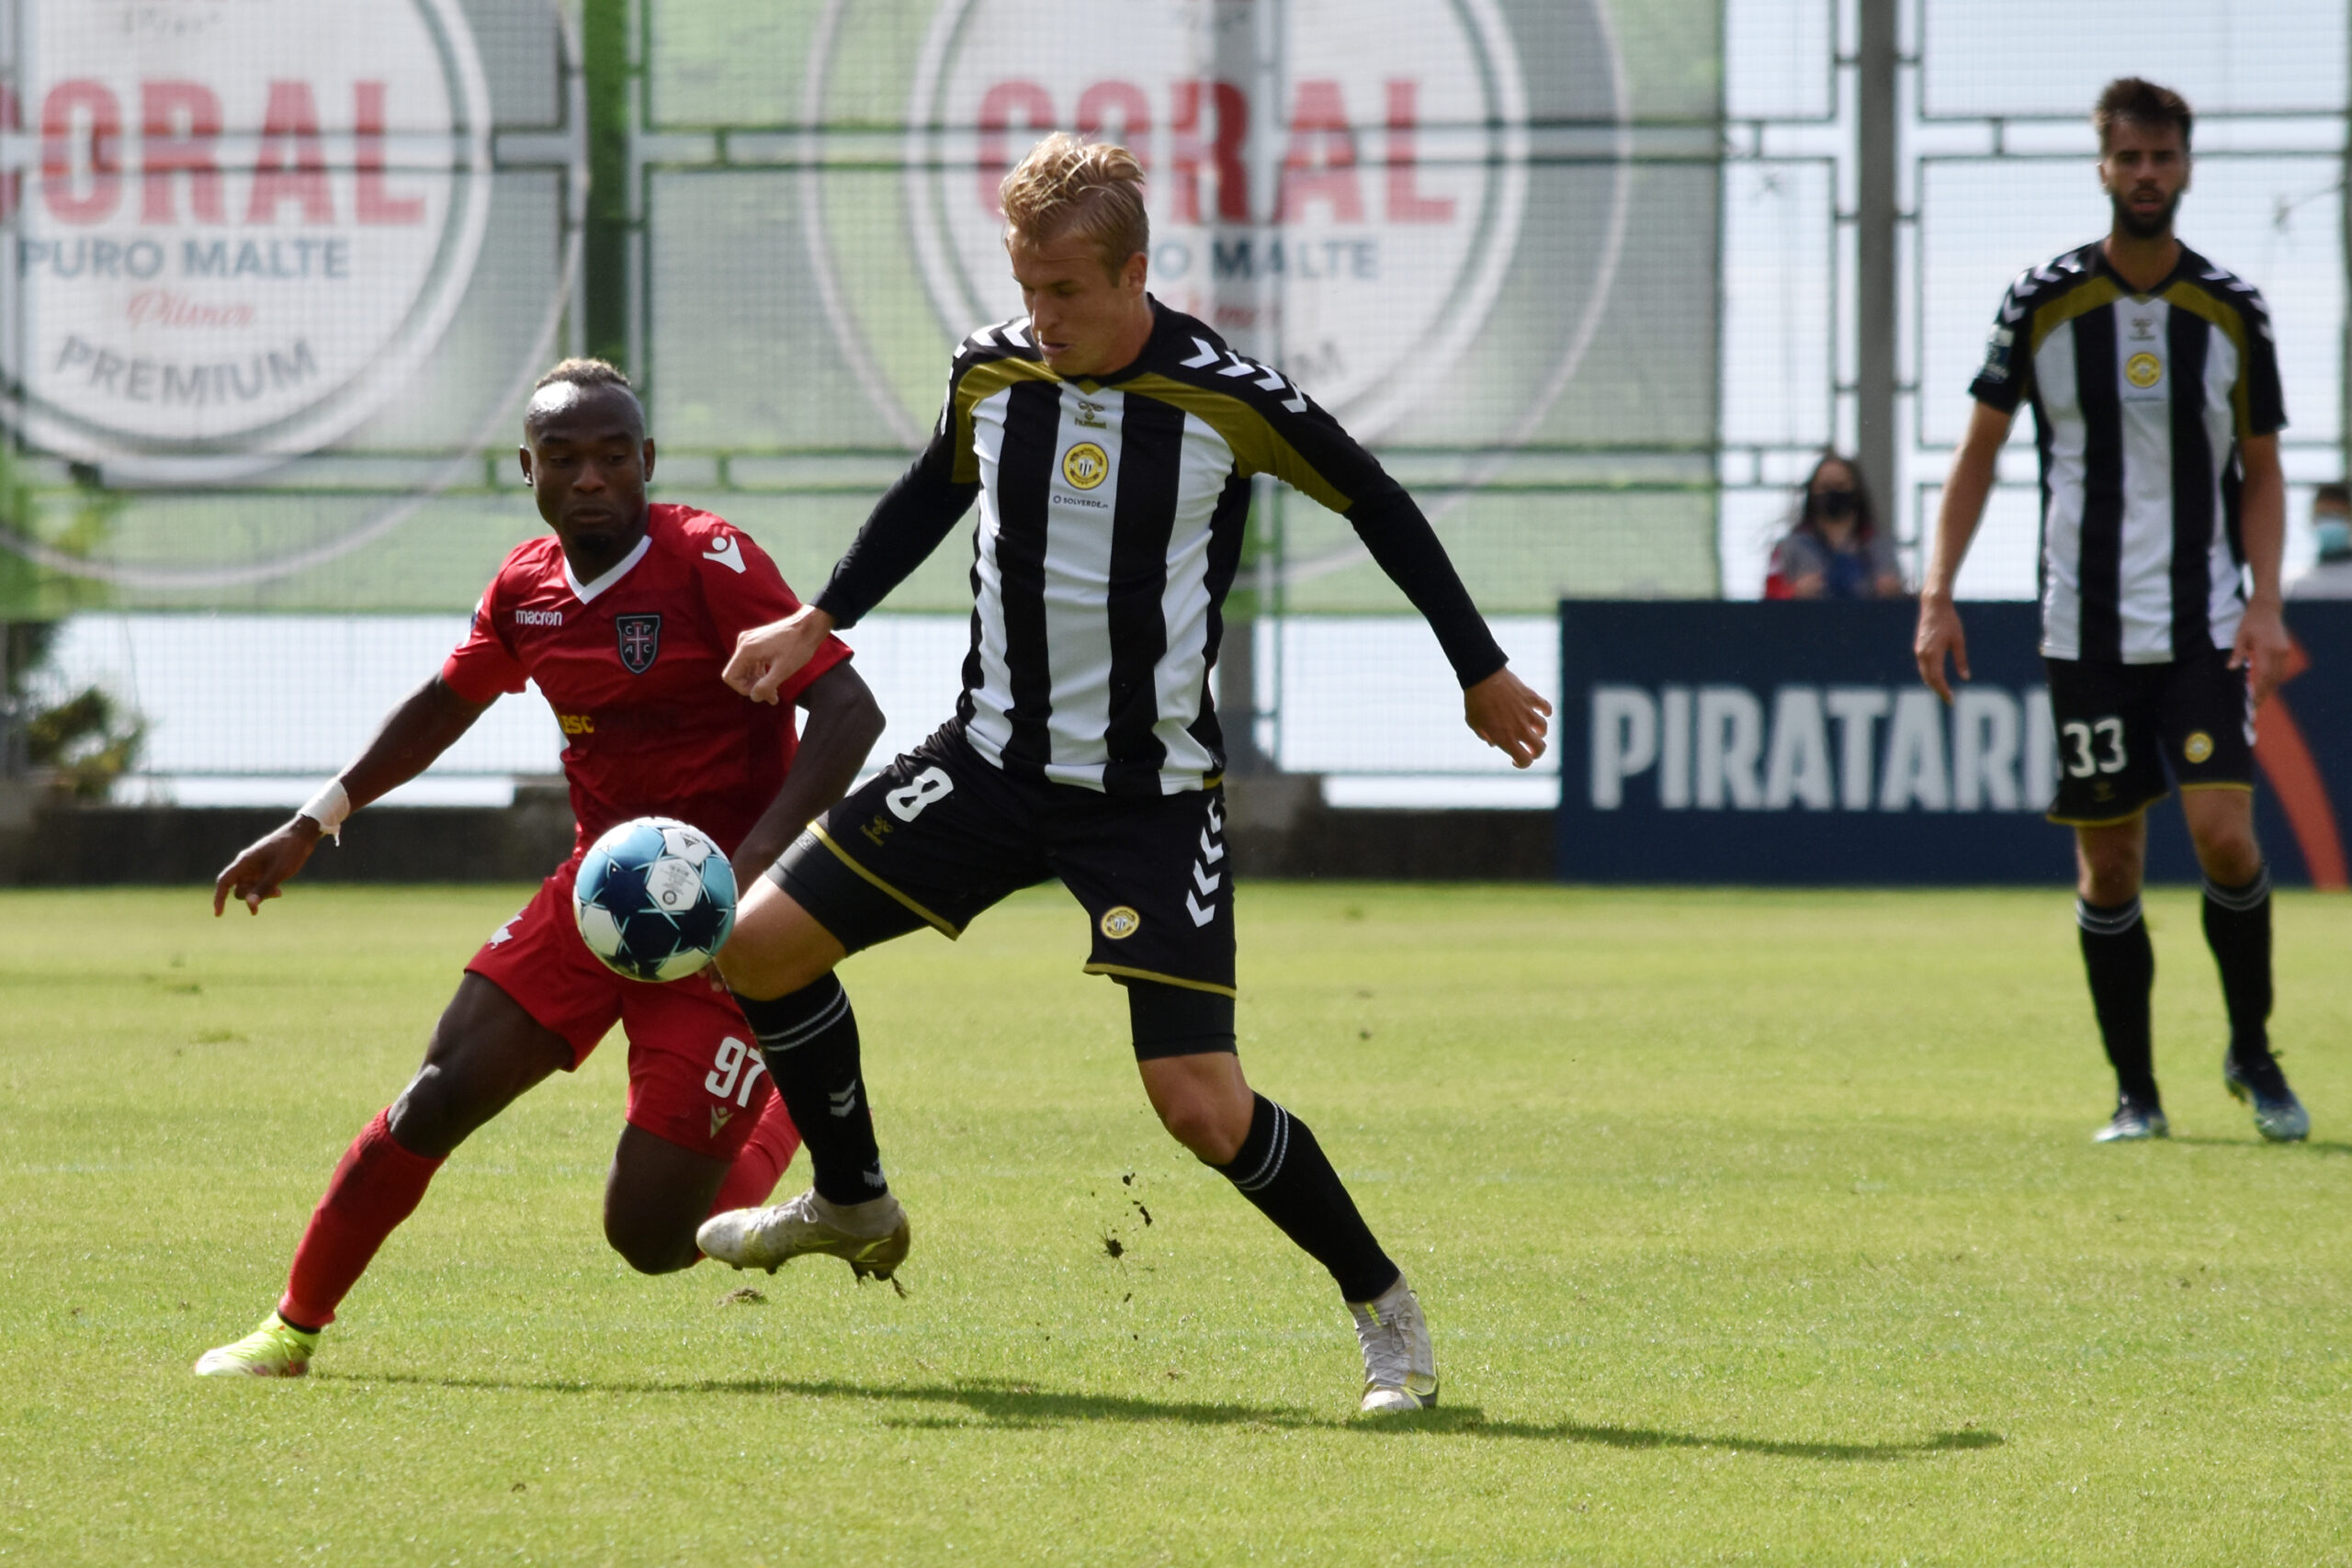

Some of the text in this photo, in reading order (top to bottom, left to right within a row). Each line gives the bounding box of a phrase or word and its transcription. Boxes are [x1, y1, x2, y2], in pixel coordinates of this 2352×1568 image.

[20, 238, 350, 278] PURO MALTE
[1213, 237, 1377, 278] MALTE
[127, 288, 257, 332] Pilsner
[55, 334, 318, 407] PREMIUM
[515, 609, 563, 626] macron
[2064, 717, 2128, 778] 33
[886, 765, 955, 822] 8
[705, 1036, 767, 1109] 97
